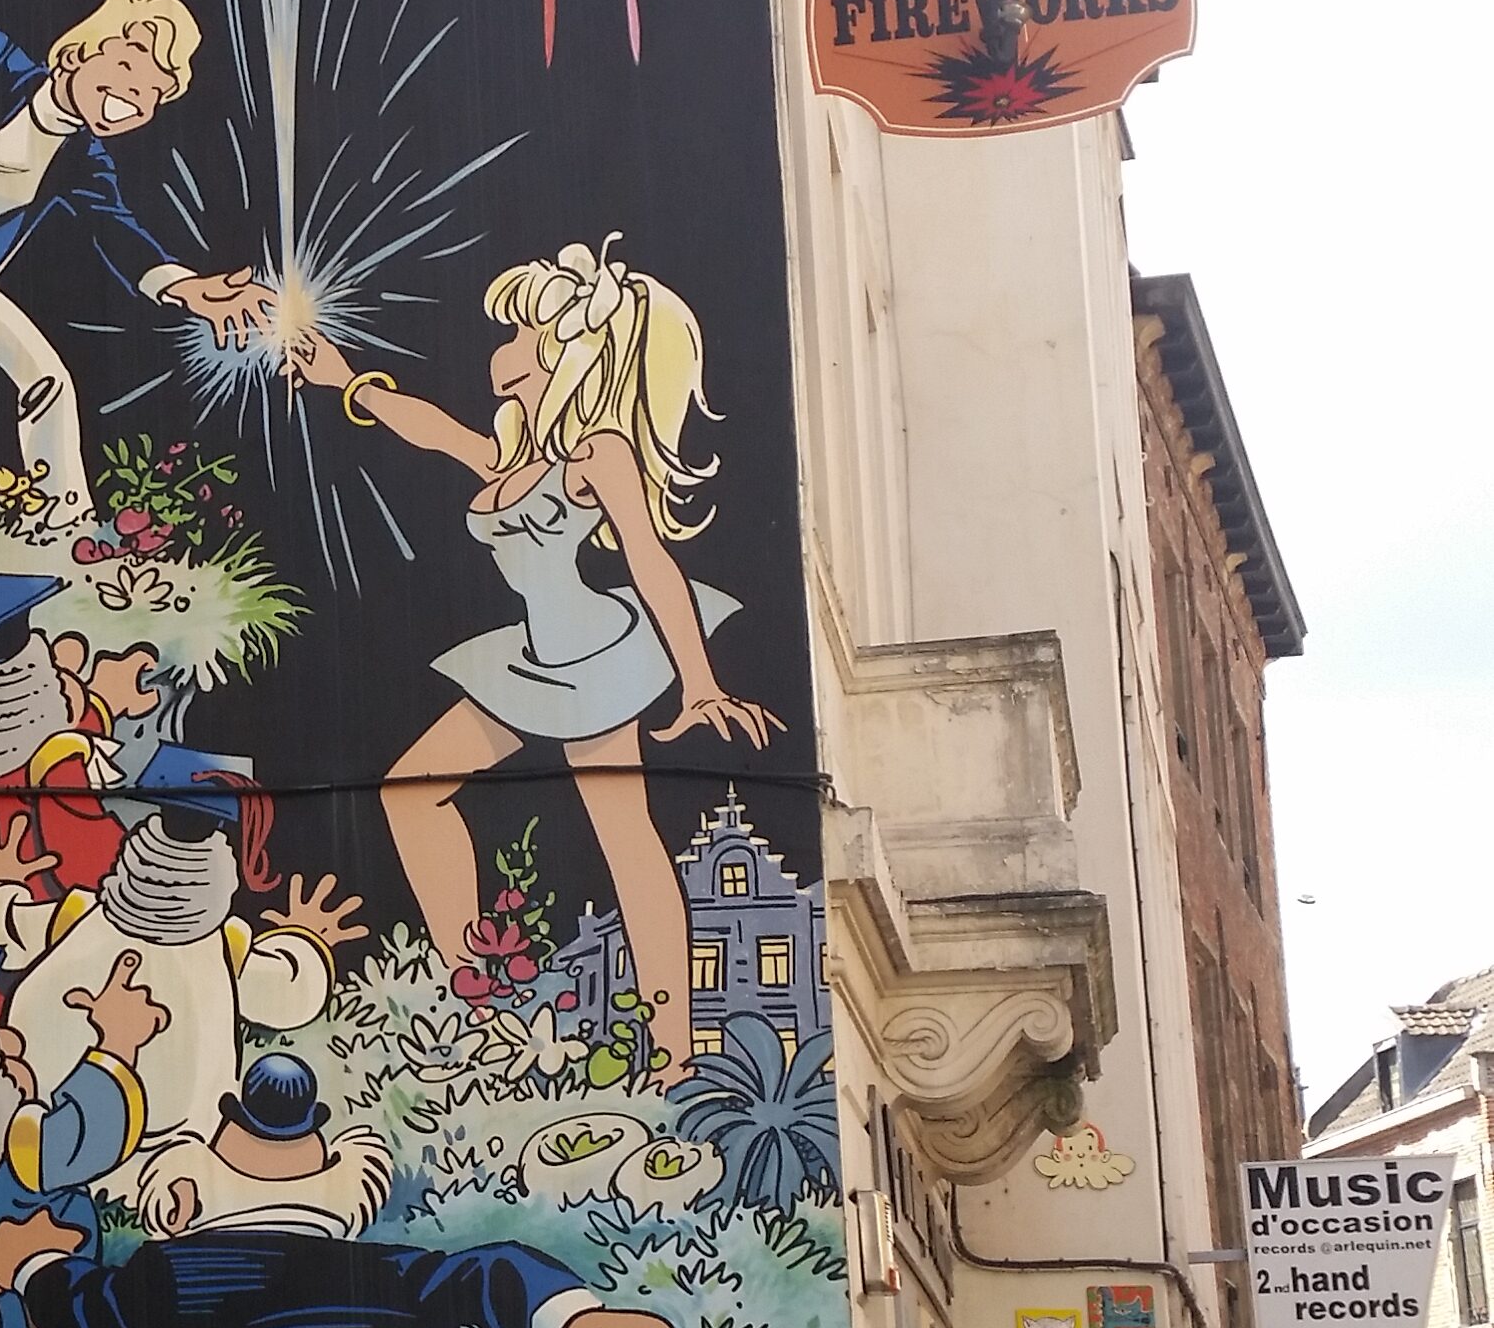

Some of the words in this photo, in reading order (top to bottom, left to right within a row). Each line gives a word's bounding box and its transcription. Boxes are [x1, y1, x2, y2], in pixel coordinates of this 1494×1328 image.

[1247, 1162, 1444, 1210] Music
[1251, 1210, 1433, 1236] d'occasion
[1254, 1243, 1316, 1254] records
[1291, 1264, 1370, 1293] hand
[1295, 1292, 1419, 1320] records
